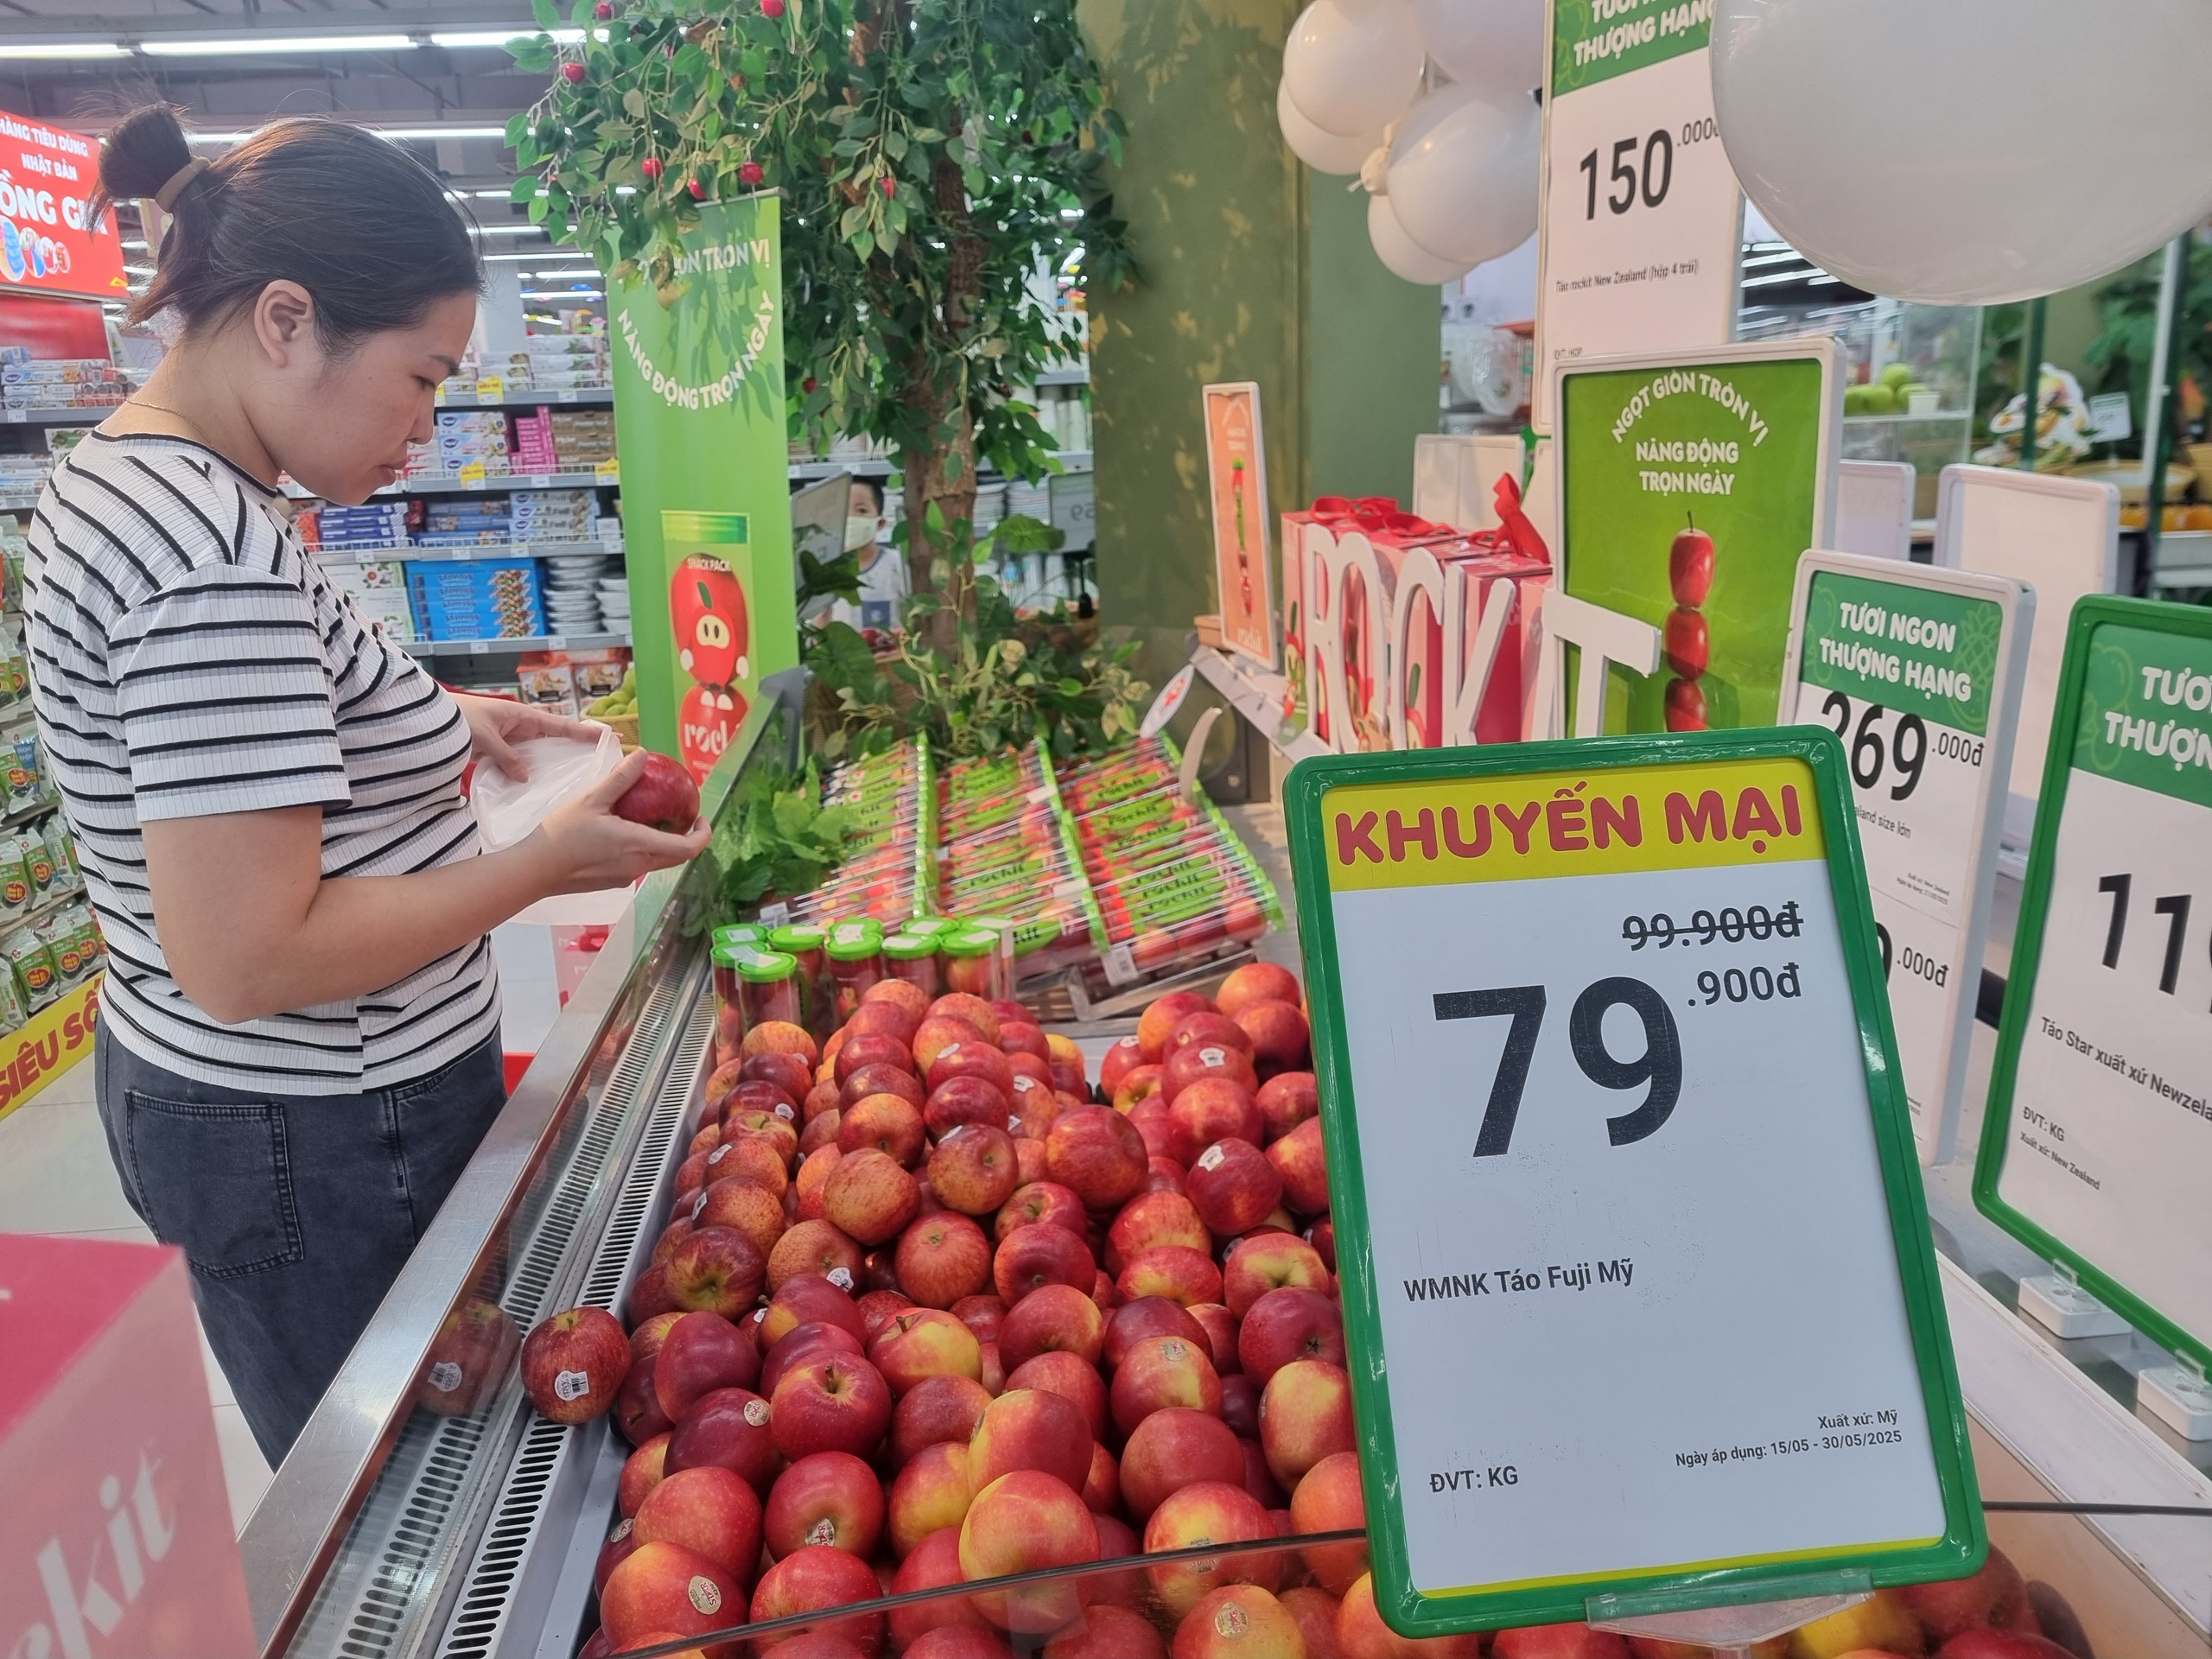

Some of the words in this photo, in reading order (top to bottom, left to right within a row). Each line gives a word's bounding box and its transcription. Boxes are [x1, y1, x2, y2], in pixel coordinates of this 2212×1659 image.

[1573, 19, 1656, 67] THƯỢNG
[31, 127, 57, 149] TIÊU
[58, 134, 89, 158] DÙNG
[21, 153, 52, 177] NHẬT
[54, 158, 79, 181] BẢN
[1580, 129, 1673, 221] 150
[751, 238, 770, 269] VỊ
[1613, 267, 1646, 285] Zealand
[652, 375, 699, 410] ĐỘNG
[699, 361, 746, 410] TRỌN
[1611, 385, 1650, 443] NGỌT
[1749, 410, 1769, 447] VỊ
[1687, 437, 1738, 467] ĐỘNG
[1639, 470, 1684, 497] TRỌN
[1839, 601, 1885, 636] TƯƠI
[1891, 611, 1957, 653] NGON
[1819, 637, 1901, 684] THƯỢNG
[1904, 658, 1972, 702] HẠNG
[2142, 666, 2212, 712] TƯƠ
[1821, 691, 1928, 802] 269
[1931, 731, 1986, 769] .000đ
[1335, 781, 1643, 865] KHUYẾN
[1664, 785, 1802, 854] MẠI
[1878, 815, 1896, 832] size
[1622, 901, 1804, 950] 99.900đ
[2098, 874, 2212, 1014] 11
[1433, 976, 1683, 1157] 79
[1687, 962, 1802, 1007] .900đ
[2041, 1016, 2063, 1041] Táo
[2066, 1031, 2094, 1057] Star
[2096, 1048, 2126, 1075] xuất
[2128, 1065, 2149, 1085] xứ
[2023, 1106, 2048, 1132] ĐVT:
[2050, 1122, 2065, 1141] KG
[2020, 1131, 2037, 1149] Xuất
[2051, 1150, 2069, 1170] New
[2069, 1163, 2101, 1191] Zealand
[1403, 1273, 1491, 1302] WMNK
[1494, 1268, 1541, 1293] Táo
[1548, 1262, 1592, 1291] Fuji
[1598, 1258, 1634, 1287] Mỹ
[1818, 1414, 1850, 1429] Xuất
[1853, 1412, 1874, 1427] xứ:
[1877, 1409, 1898, 1426] Mỹ
[1675, 1451, 1708, 1468] Ngày
[1712, 1449, 1727, 1464] áp
[1731, 1446, 1768, 1461] dụng:
[1770, 1439, 1809, 1455] 15/05
[1821, 1430, 1903, 1450] 30/05/2025
[1430, 1469, 1482, 1493] ĐVT:
[1488, 1465, 1518, 1487] KG
[700, 1582, 716, 1606] STAR
